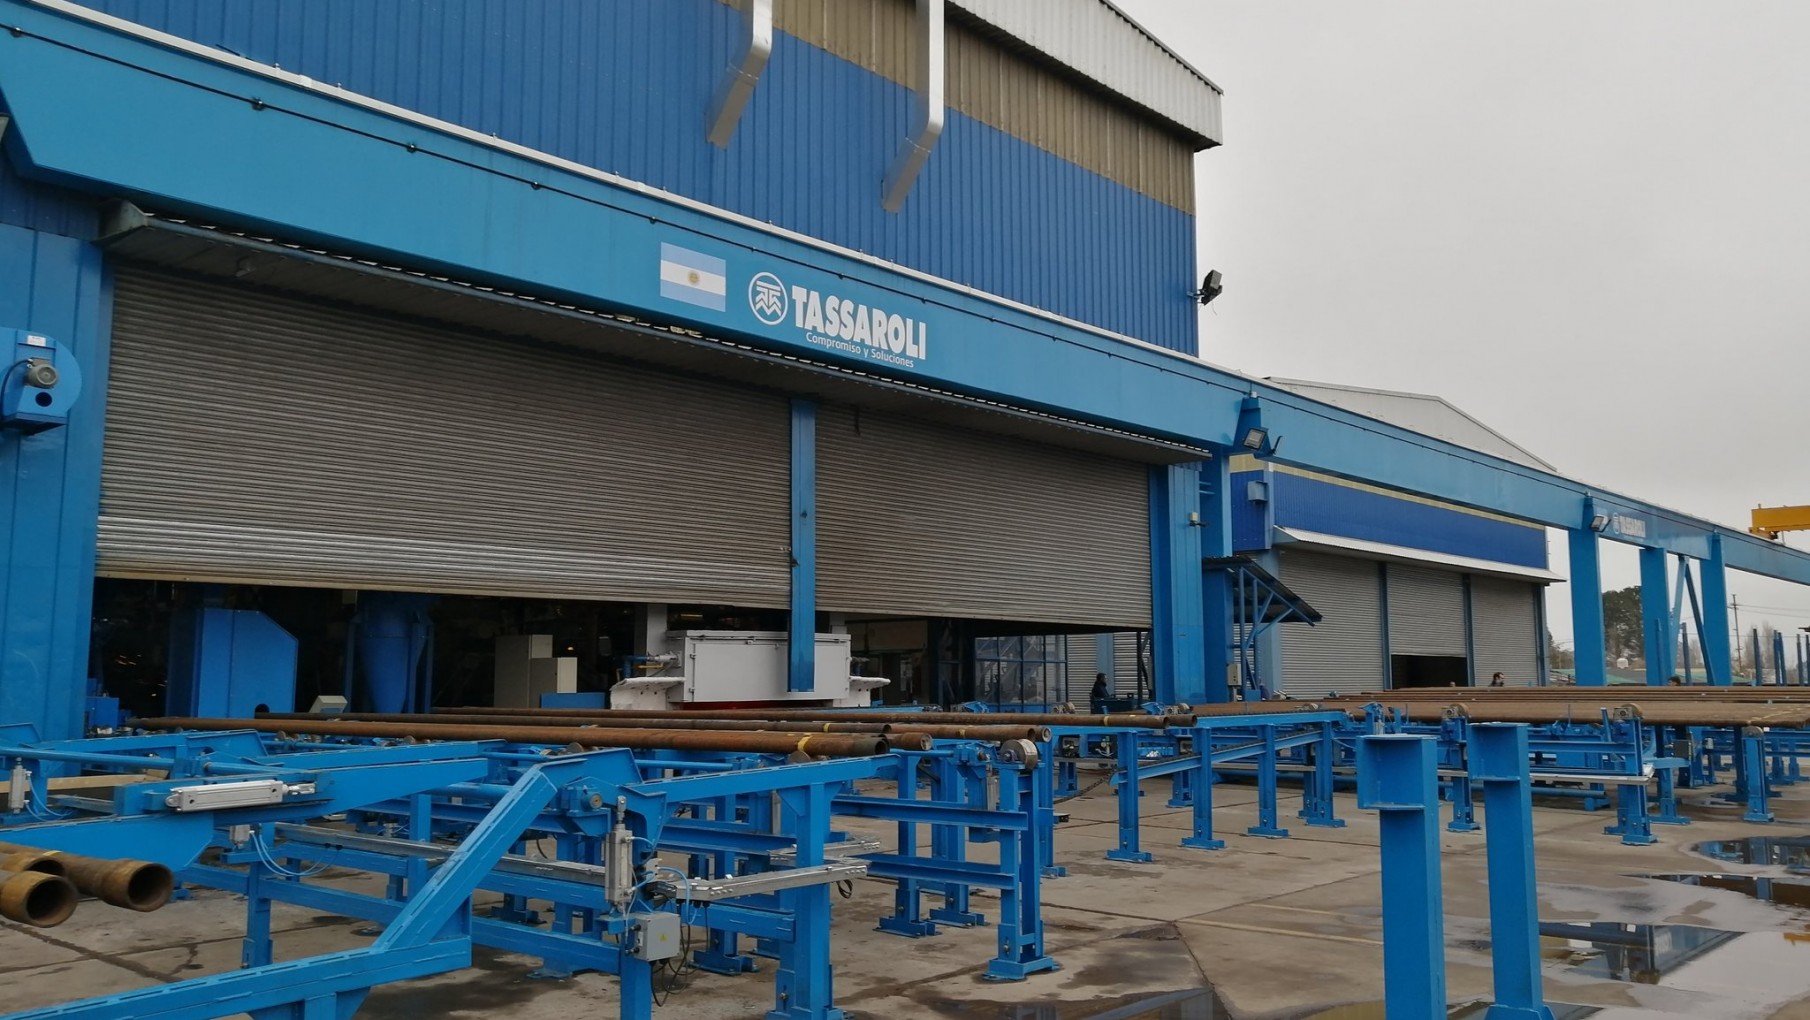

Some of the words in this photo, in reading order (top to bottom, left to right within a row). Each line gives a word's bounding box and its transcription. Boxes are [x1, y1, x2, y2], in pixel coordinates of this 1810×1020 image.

[792, 285, 926, 360] TASSAROLI
[806, 332, 861, 353] Compromiso
[863, 348, 869, 358] y
[871, 348, 914, 368] Soluciones
